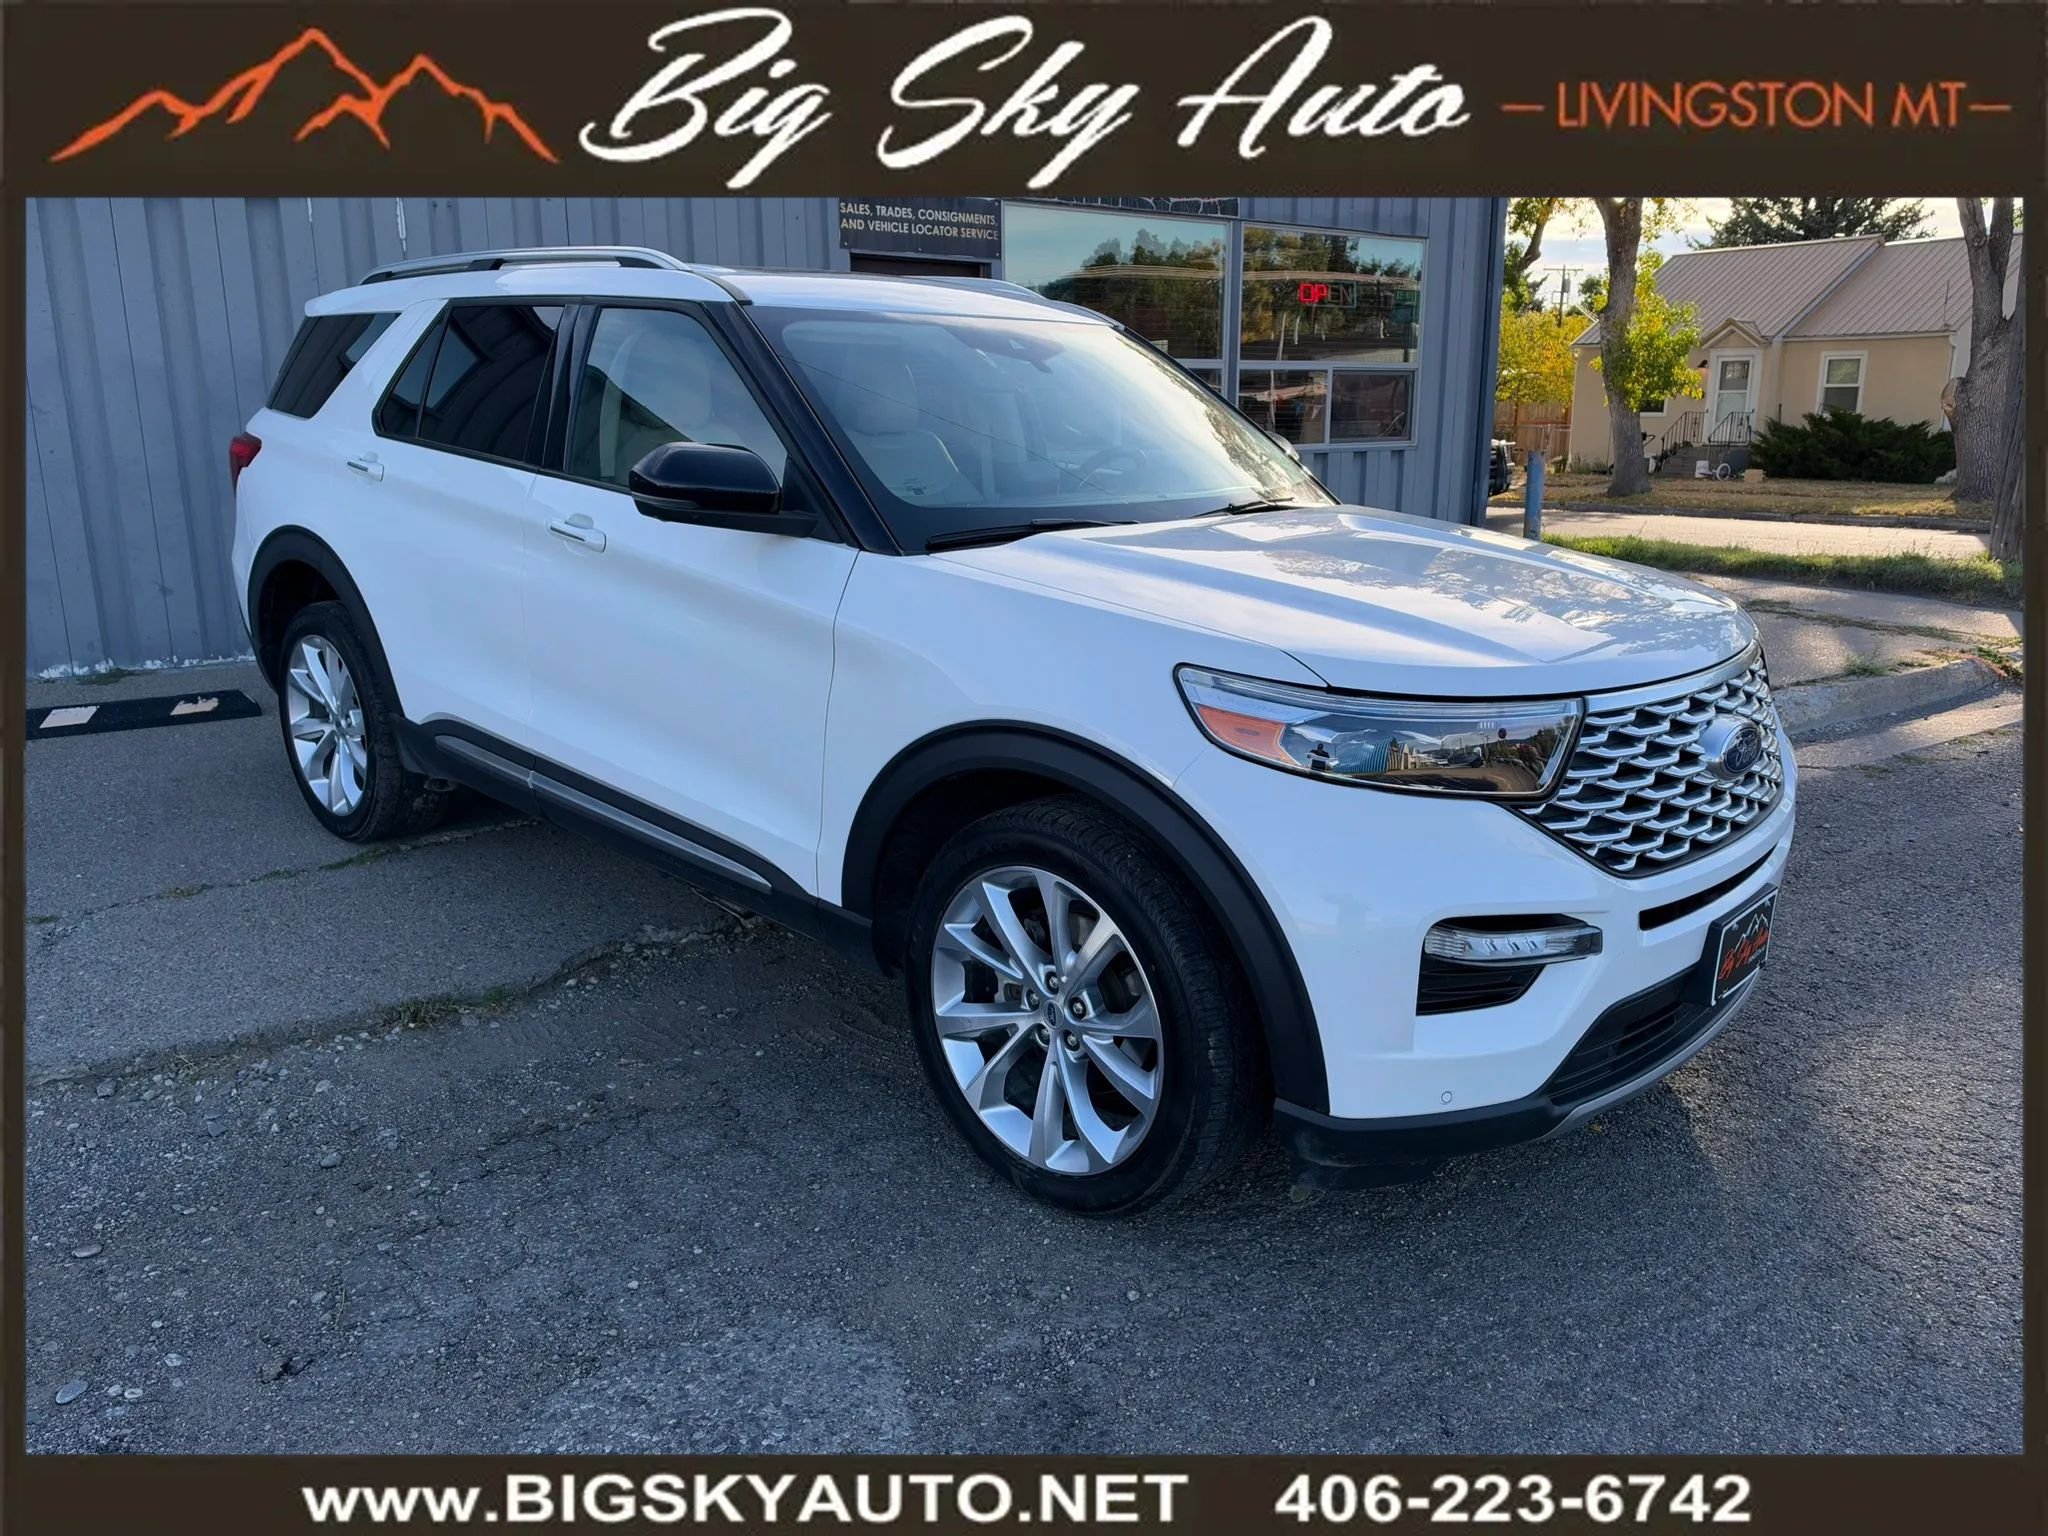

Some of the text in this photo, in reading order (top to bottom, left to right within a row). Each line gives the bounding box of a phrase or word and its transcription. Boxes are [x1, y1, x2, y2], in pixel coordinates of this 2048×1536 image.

[840, 202, 998, 226] SALES, TRADES, CONSIGNMENTS,
[840, 218, 999, 241] AND VEHICLE LOCATOR SERVICE
[1299, 282, 1352, 304] OPEN
